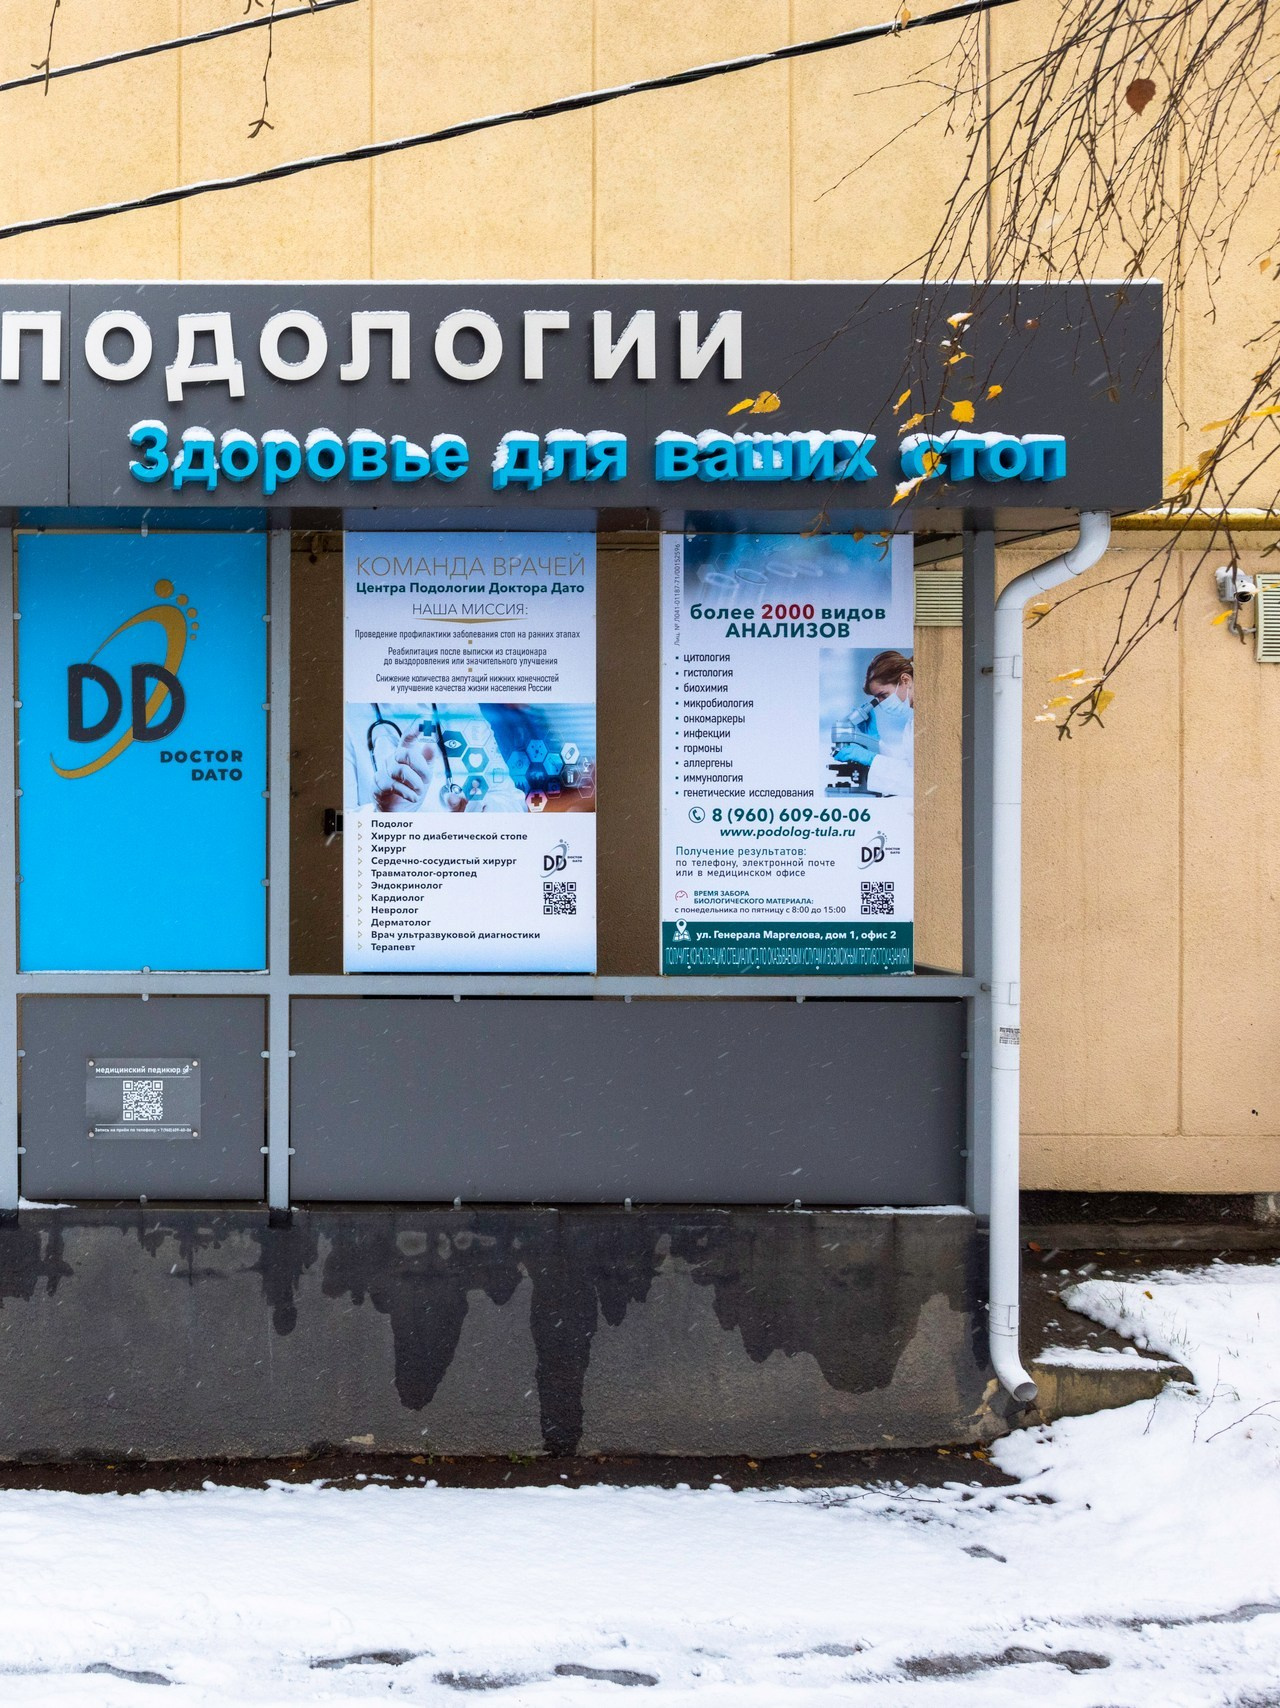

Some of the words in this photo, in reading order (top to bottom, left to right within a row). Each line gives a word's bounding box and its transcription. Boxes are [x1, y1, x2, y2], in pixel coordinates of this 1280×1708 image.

[1, 309, 743, 402] подологии
[129, 420, 470, 495] Здоровье
[492, 430, 628, 491] для
[655, 429, 878, 482] ваших
[899, 430, 1067, 484] стоп
[357, 556, 486, 580] КОМАНДА
[493, 553, 586, 577] ВРАЧЕЙ
[356, 582, 406, 595] Центра
[410, 582, 485, 594] Подологии
[488, 582, 547, 595] Доктора
[551, 582, 584, 595] Дато
[412, 603, 458, 615] НАША
[462, 603, 528, 615] МИССИЯ:
[690, 603, 755, 620] более
[761, 604, 815, 620] 2000
[821, 608, 886, 622] видов
[355, 629, 398, 639] Проведение
[399, 630, 451, 639] профилактики
[452, 629, 499, 638] заболевания
[528, 631, 554, 639] ранних
[725, 622, 850, 638] АНАЛИЗОВ
[388, 647, 438, 656] Реабилитация
[383, 658, 393, 666] до
[394, 658, 450, 666] выздоровления
[519, 658, 558, 666] улучшения
[683, 654, 730, 663] цитология
[376, 673, 410, 682] Снижение
[451, 673, 488, 683] ампутаций
[517, 673, 559, 683] конечностей
[683, 669, 733, 677] гистология
[396, 685, 434, 693] улучшение
[435, 683, 466, 692] качества
[528, 683, 552, 692] России
[683, 683, 729, 693] биохимия
[68, 663, 186, 743] DD
[683, 698, 754, 708] микробиология
[683, 715, 745, 724] онкомаркеры
[683, 729, 731, 739] инфекции
[683, 745, 723, 754] гормоны
[160, 750, 243, 763] DOCTOR
[683, 760, 733, 769] аллергены
[191, 768, 243, 781] DATO
[683, 775, 743, 783] иммунология
[683, 789, 746, 797] генетические
[749, 789, 814, 798] исследования
[712, 808, 722, 822] 8
[727, 808, 774, 824] (960)
[779, 808, 871, 822] 609-60-06
[371, 820, 413, 829] Подолог
[371, 832, 407, 841] Хирург
[423, 832, 498, 841] диабетической
[720, 826, 856, 839] www.podolog-tula.ru
[371, 844, 407, 854] Хирург
[676, 846, 734, 857] Получение
[738, 848, 806, 857] результатов:
[371, 856, 480, 866] Сердечно-сосудистый
[692, 859, 738, 869] телефону,
[742, 858, 804, 869] электронной
[371, 869, 477, 879] Травматолог-ортопед
[707, 870, 772, 878] медицинском
[776, 869, 806, 878] офисе
[371, 881, 443, 891] Эндокринолог
[371, 894, 425, 903] Кардиолог
[371, 906, 419, 915] Невролог
[680, 907, 738, 915] понедельника
[791, 906, 810, 915] 8:00
[824, 906, 846, 914] 15:00
[371, 918, 431, 928] Дерматолог
[371, 930, 395, 940] Врач
[397, 931, 476, 940] ультразвуковой
[478, 932, 540, 940] диагностики
[696, 932, 712, 941] ул.
[714, 930, 761, 941] Генерала
[763, 930, 823, 941] Маргелова,
[825, 932, 847, 940] дом
[850, 930, 859, 940] 1,
[861, 930, 888, 941] офис
[890, 930, 896, 939] 2
[371, 943, 415, 952] Терапевт
[95, 1066, 146, 1074] медицинский
